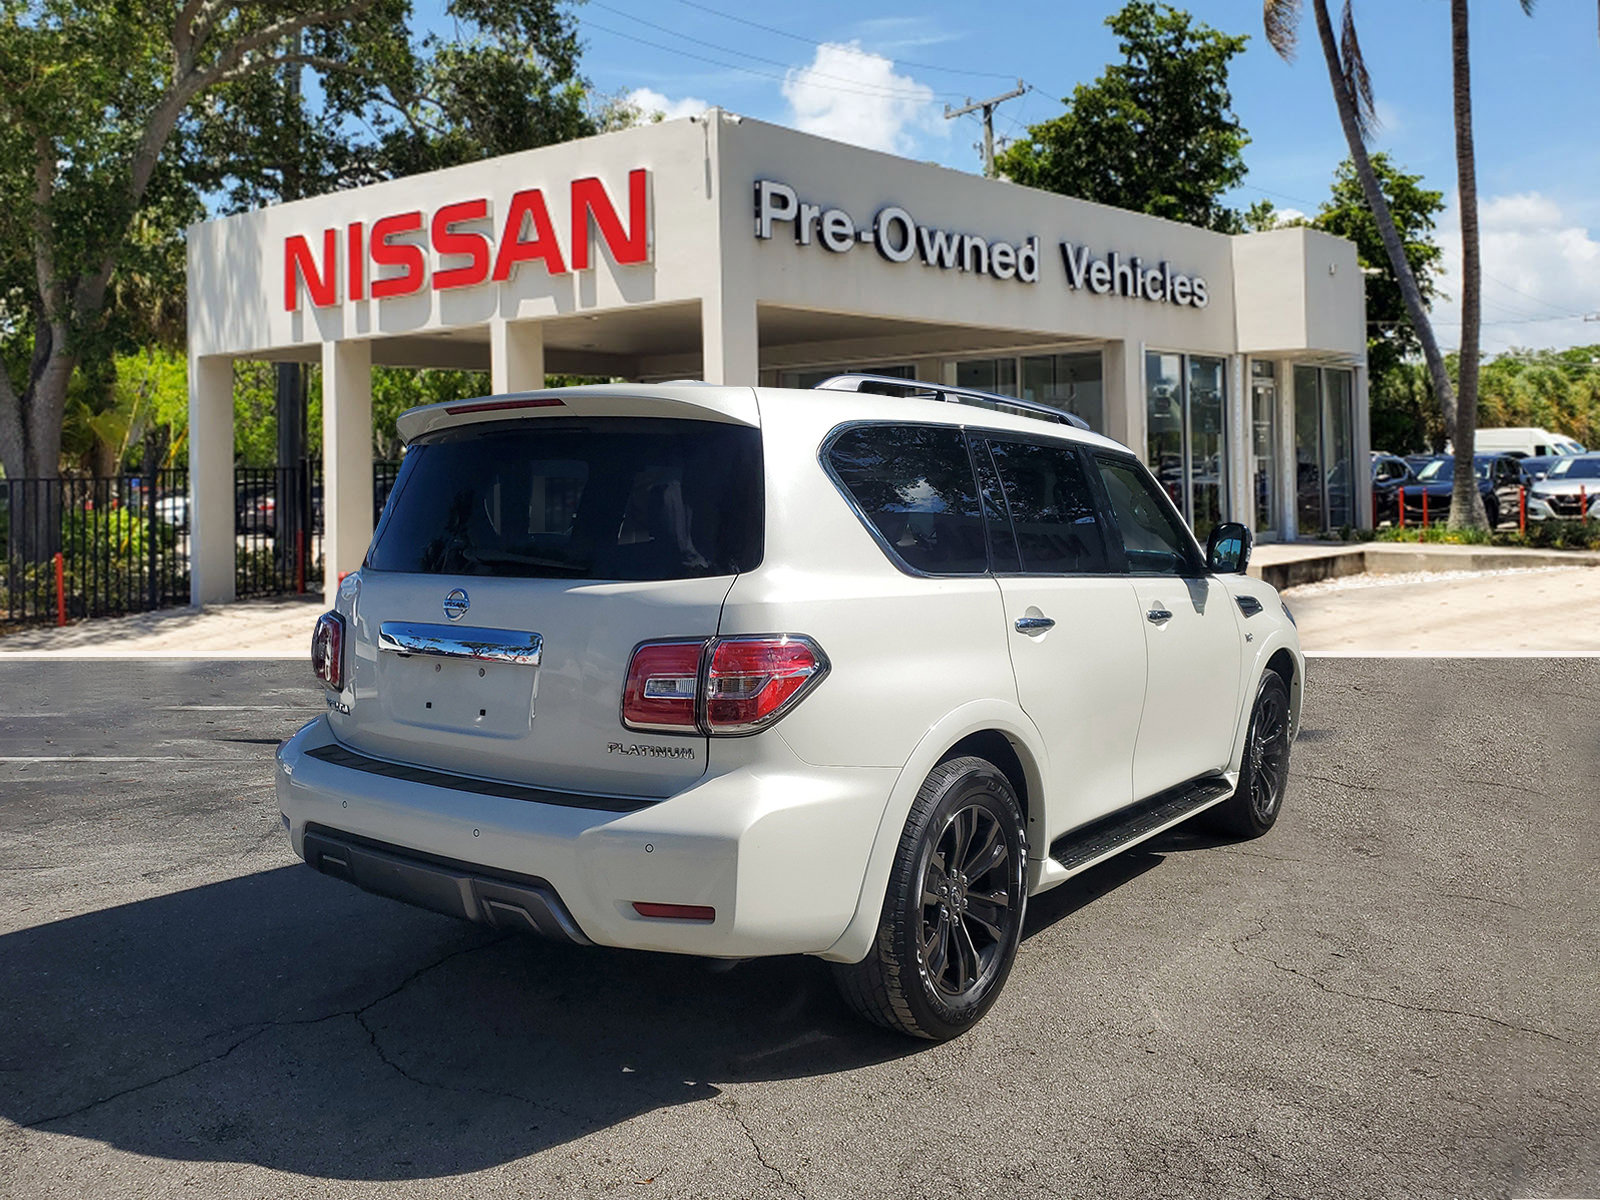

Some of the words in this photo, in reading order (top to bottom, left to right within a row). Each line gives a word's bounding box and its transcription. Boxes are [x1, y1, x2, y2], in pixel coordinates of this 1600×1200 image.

[284, 168, 650, 311] NISSAN
[754, 179, 1040, 284] Pre-Owned
[1060, 241, 1208, 308] Vehicles
[607, 742, 695, 760] PLATINUM
